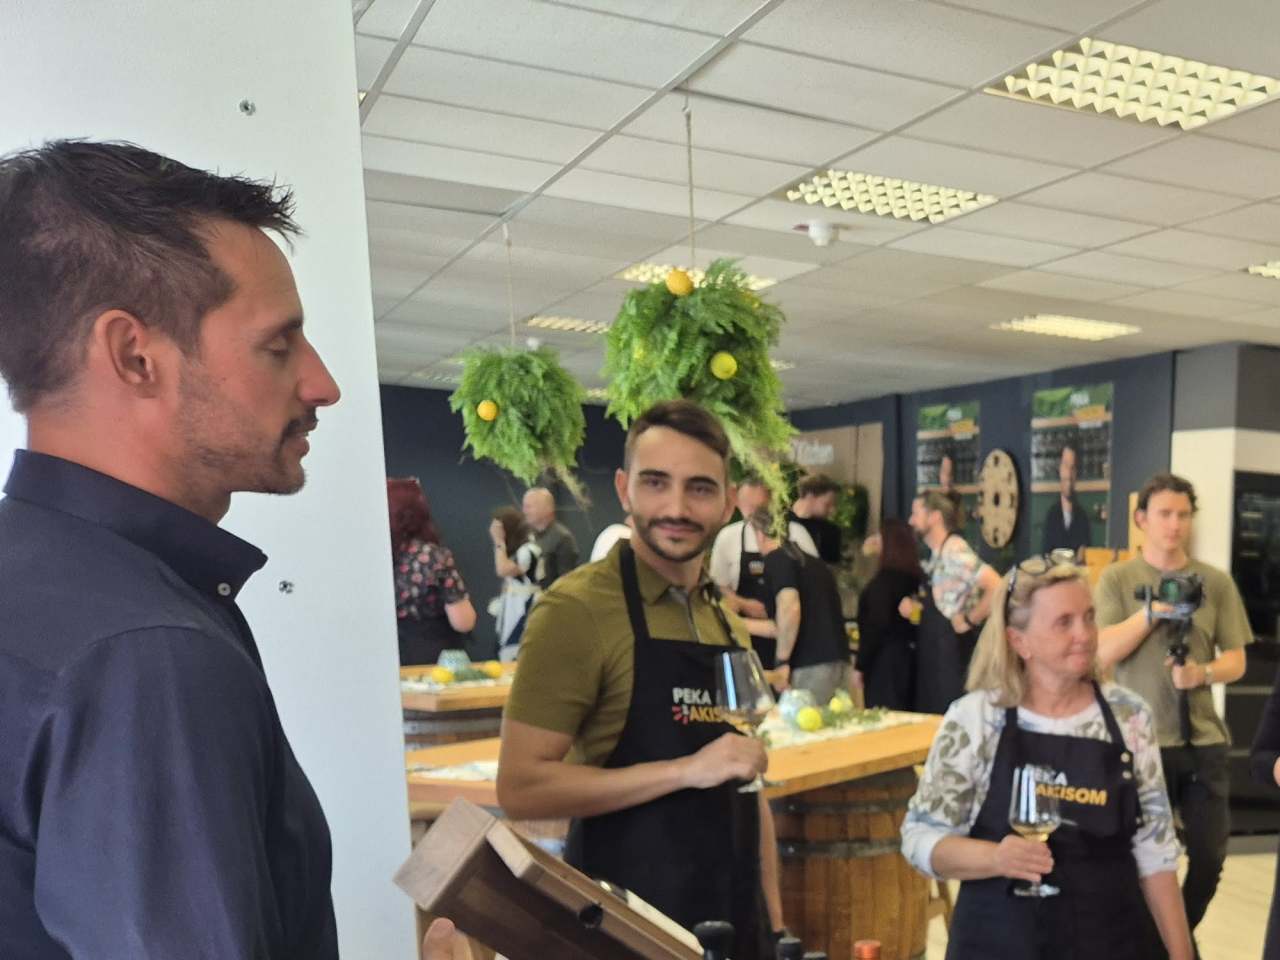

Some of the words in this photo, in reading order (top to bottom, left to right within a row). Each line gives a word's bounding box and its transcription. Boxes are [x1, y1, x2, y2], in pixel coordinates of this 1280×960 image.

[672, 687, 712, 705] PEKA
[690, 705, 740, 723] AKIS
[1036, 784, 1107, 805] AKISOM
